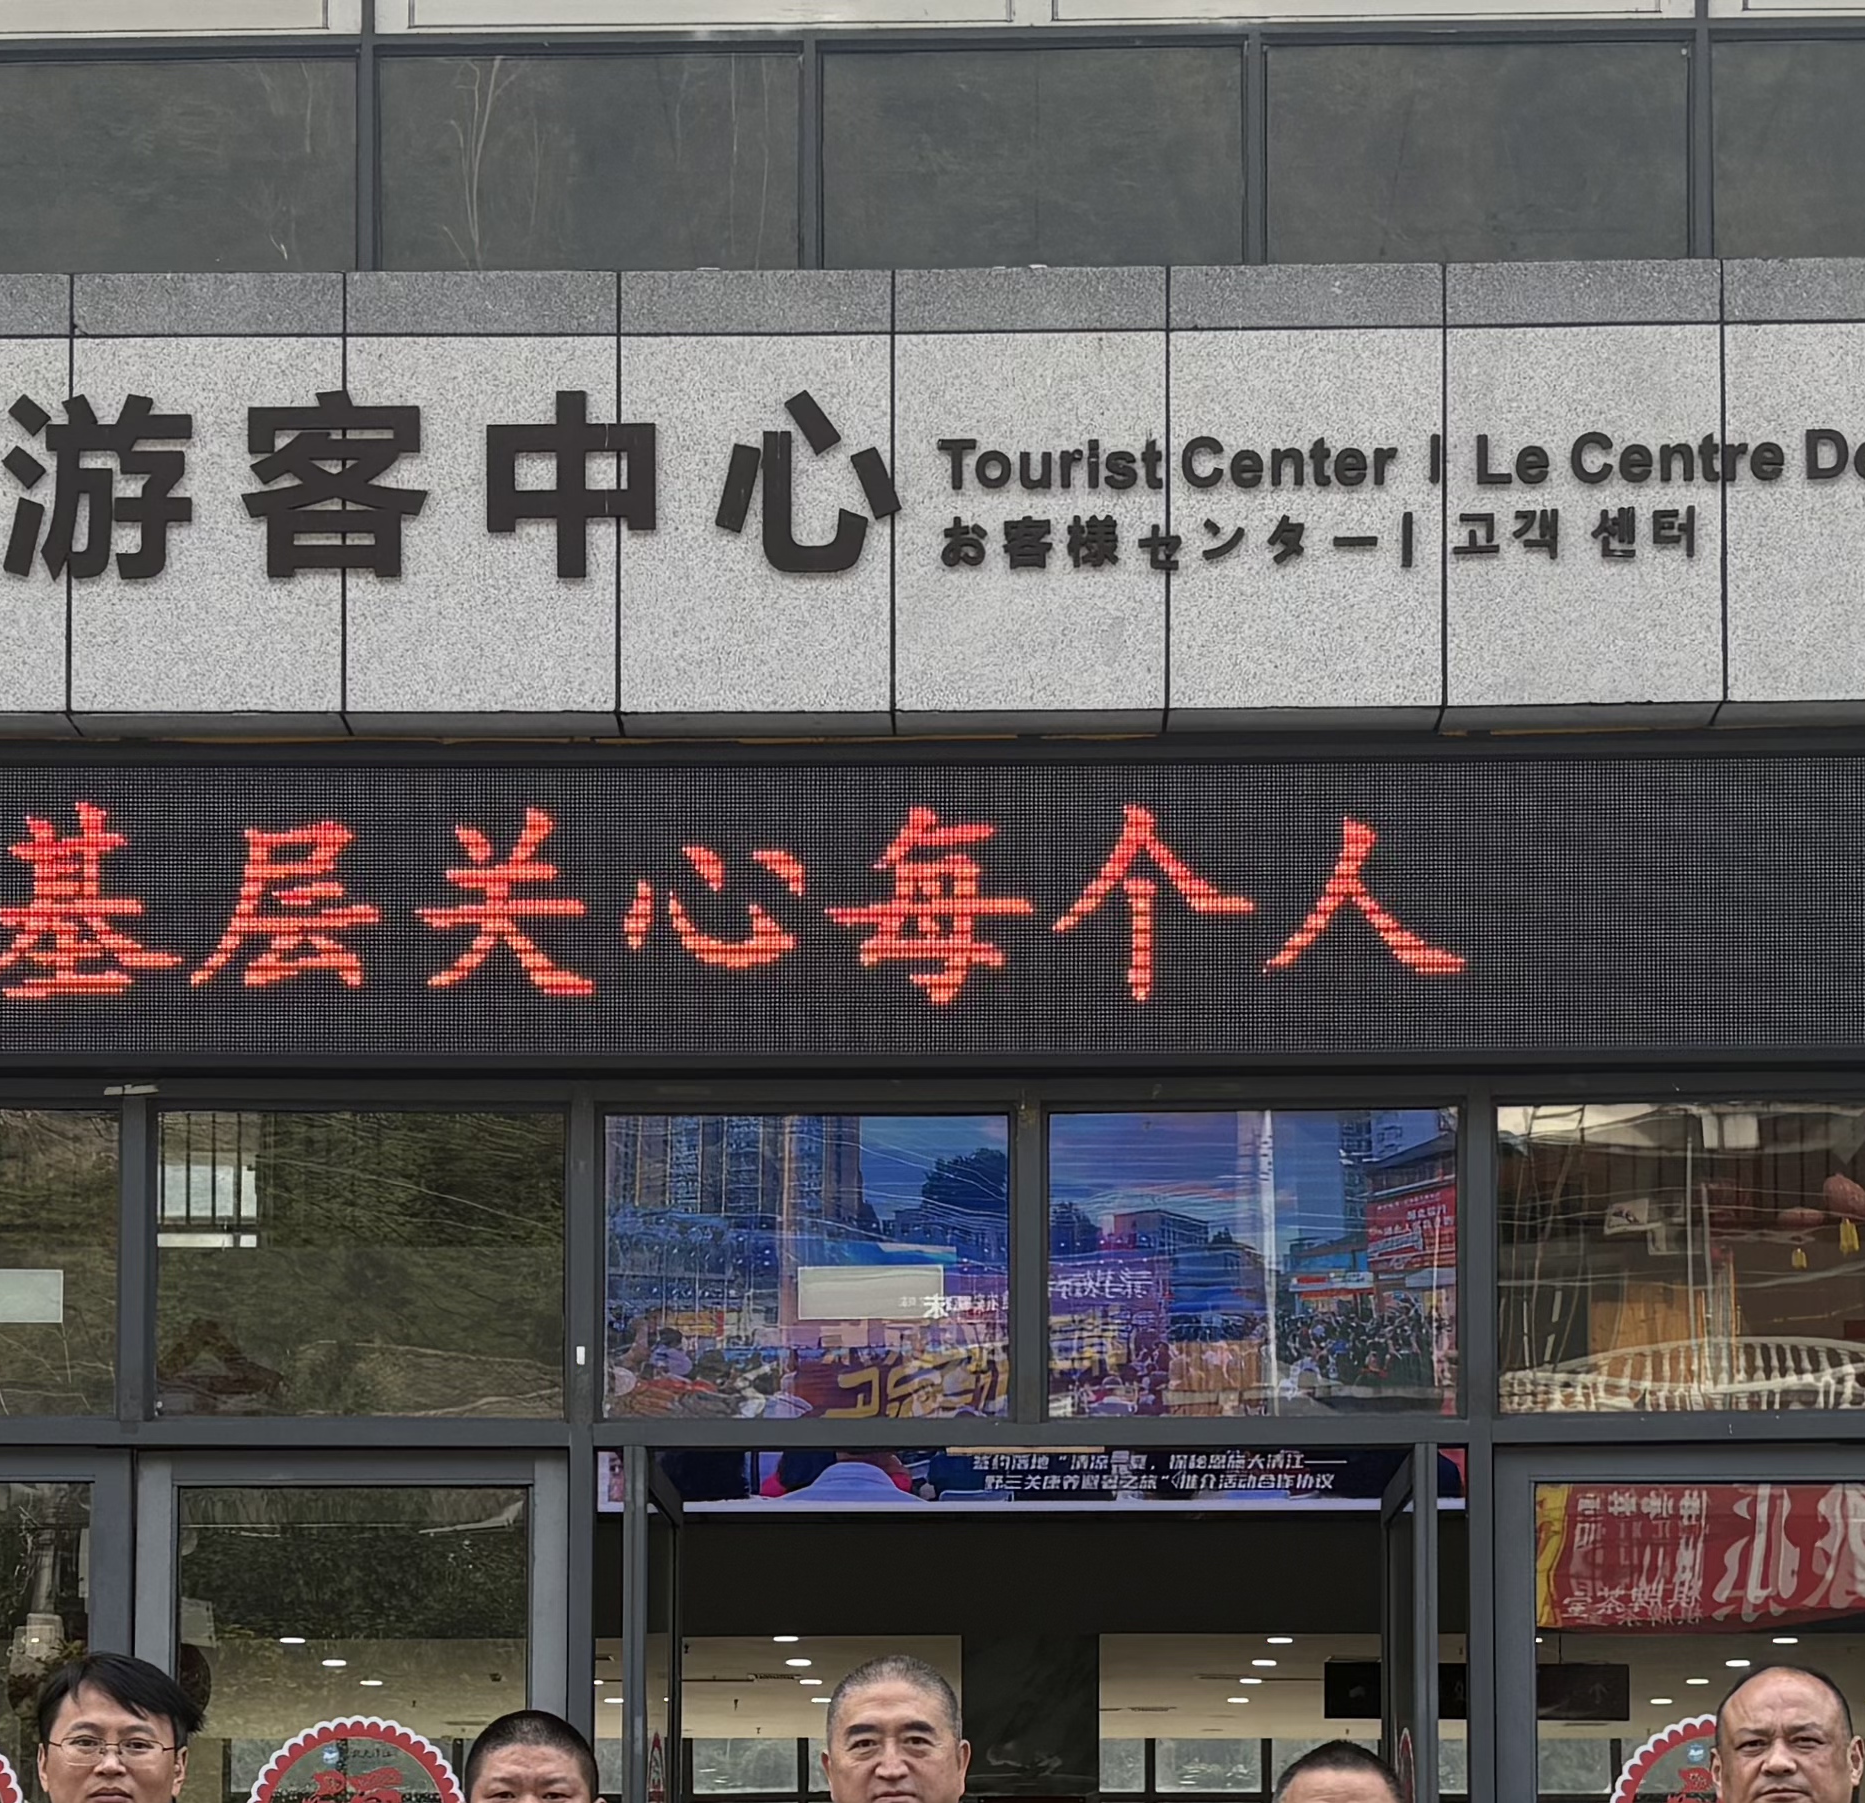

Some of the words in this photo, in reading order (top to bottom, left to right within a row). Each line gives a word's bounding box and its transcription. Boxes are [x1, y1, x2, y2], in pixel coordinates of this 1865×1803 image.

[1, 389, 902, 580] 游客中心
[937, 437, 1164, 491] Tourist
[1181, 436, 1399, 489] Center
[1476, 433, 1550, 486] Le
[1571, 431, 1785, 485] Centre
[941, 513, 1379, 571] お客様センター
[1453, 508, 1559, 560] 고객
[1591, 505, 1696, 559] 센터
